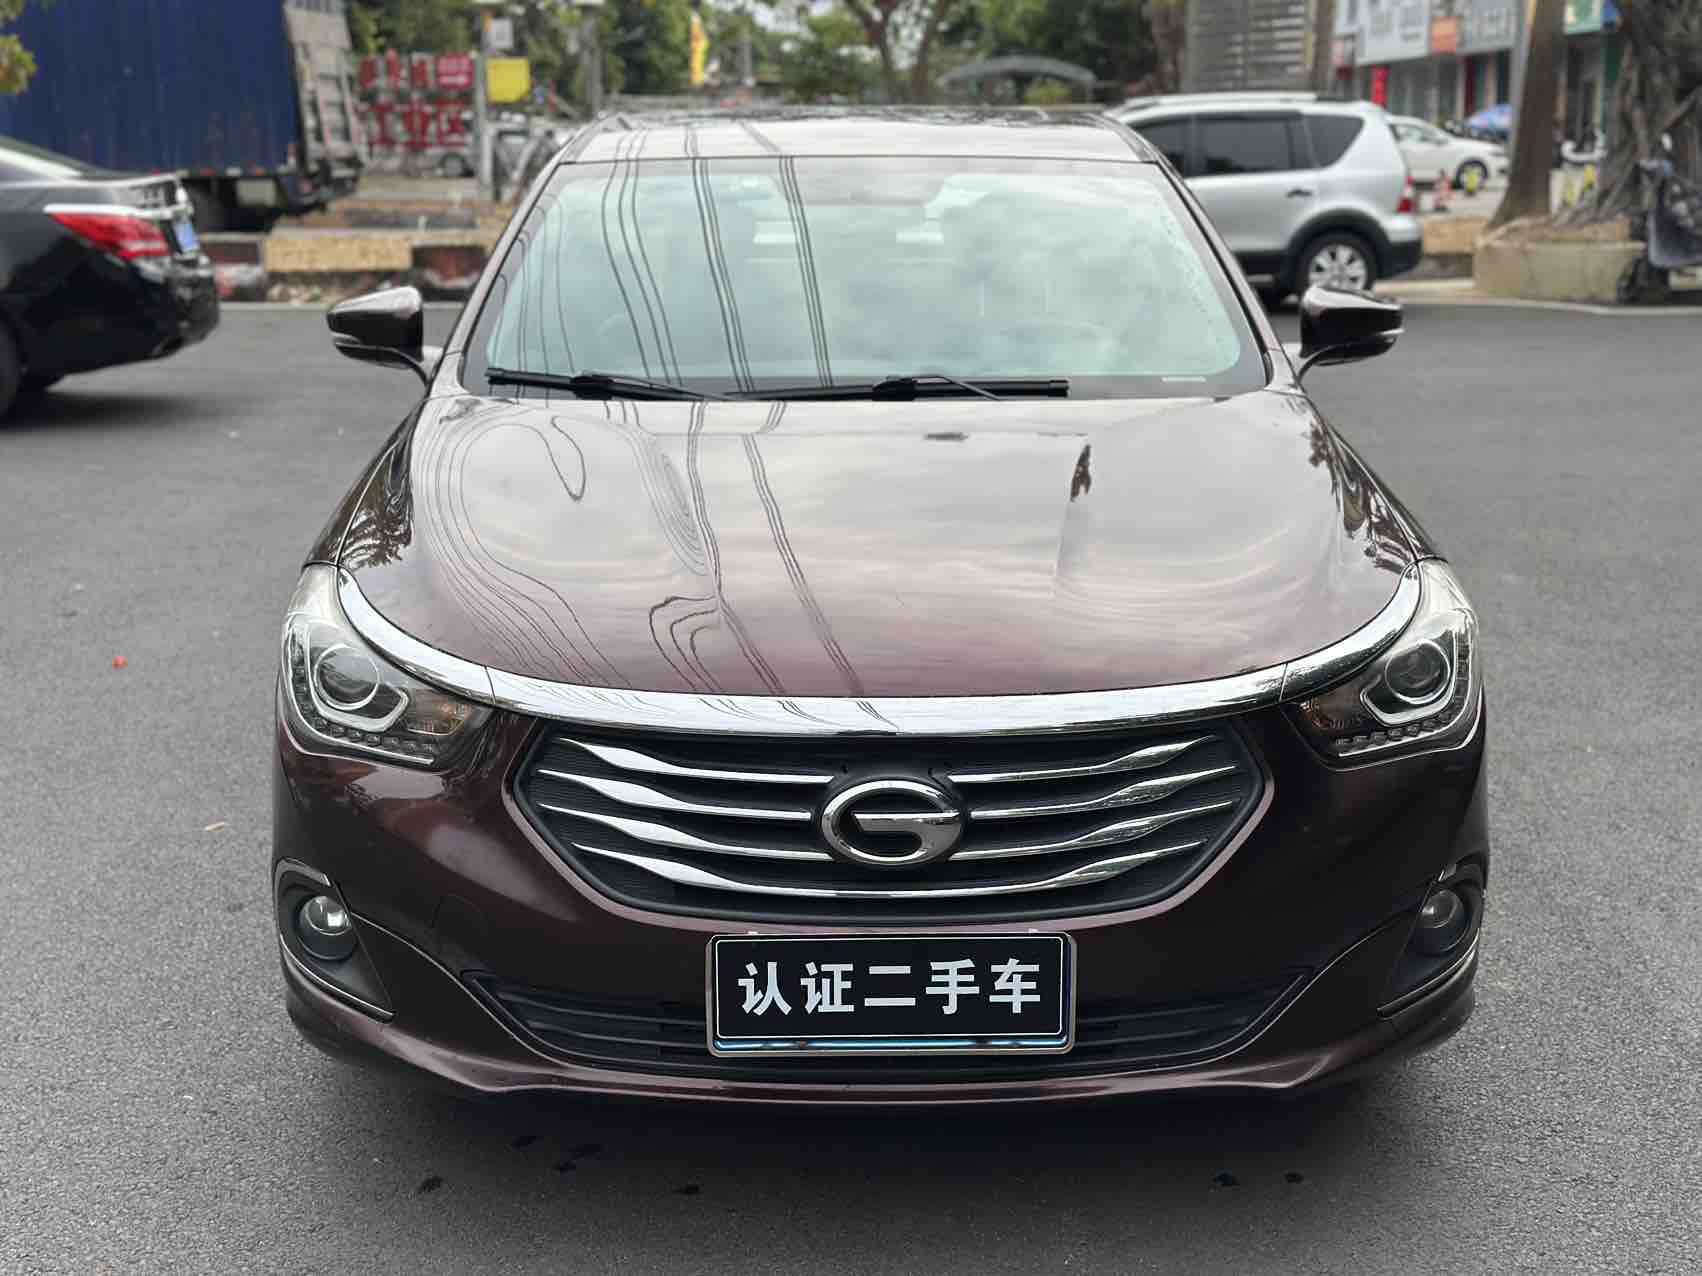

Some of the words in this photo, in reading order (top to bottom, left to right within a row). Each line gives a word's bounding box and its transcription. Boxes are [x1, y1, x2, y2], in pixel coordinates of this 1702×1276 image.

[738, 958, 1041, 1015] 认证二手车
